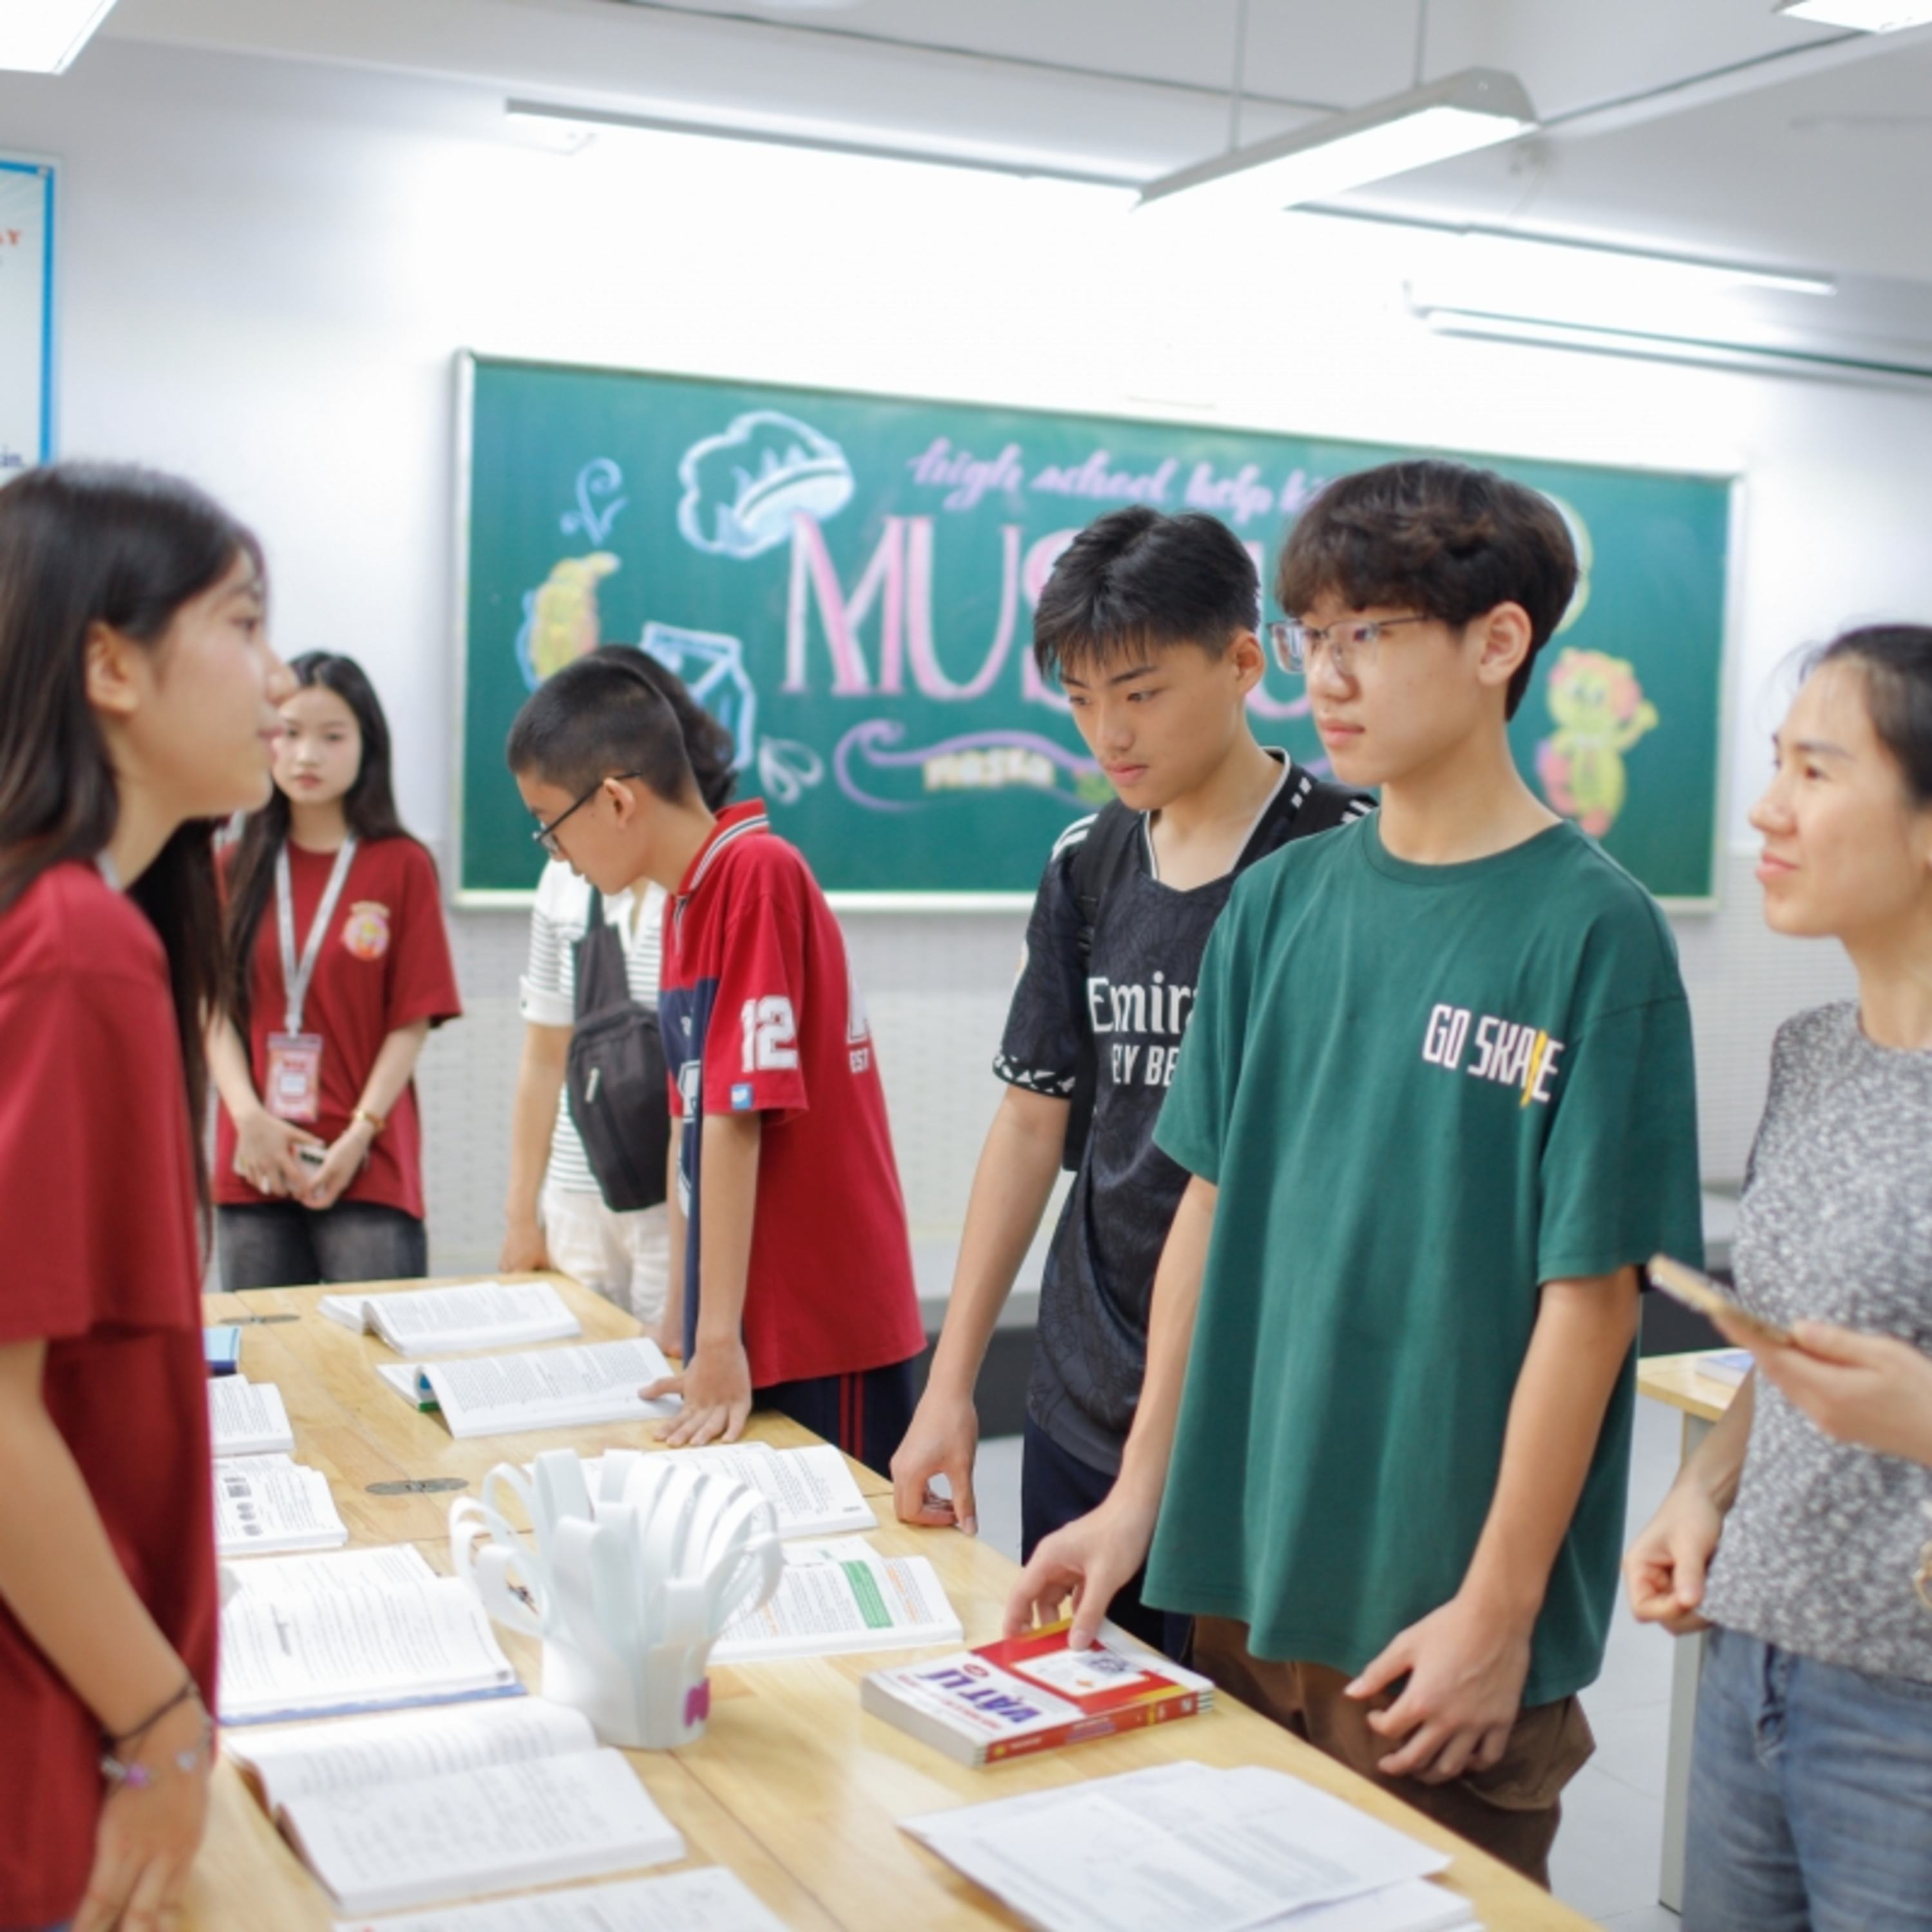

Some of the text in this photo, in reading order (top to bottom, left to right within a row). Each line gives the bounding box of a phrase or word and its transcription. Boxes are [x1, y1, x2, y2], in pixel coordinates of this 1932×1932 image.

[906, 437, 1022, 509] high
[741, 995, 798, 1073] 12
[1422, 1003, 1472, 1071] GO
